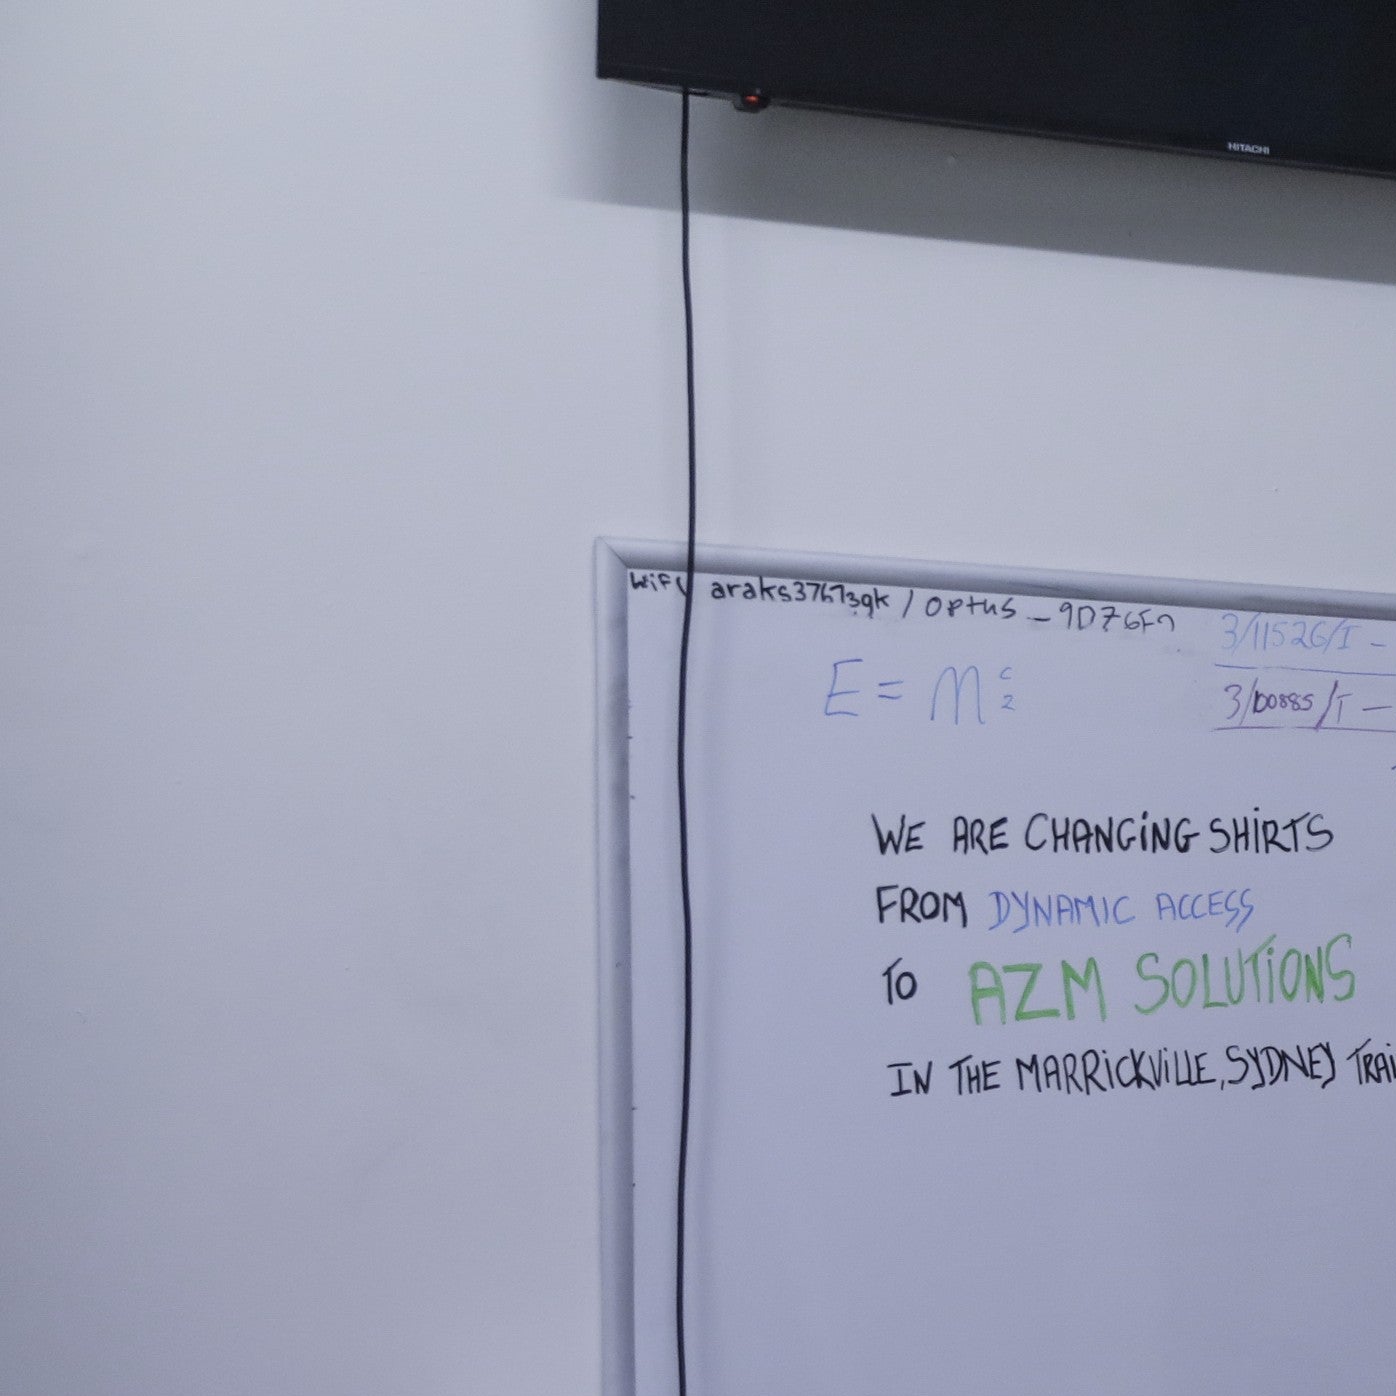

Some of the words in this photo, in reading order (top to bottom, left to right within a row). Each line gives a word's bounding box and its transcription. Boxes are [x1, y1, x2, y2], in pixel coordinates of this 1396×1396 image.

[872, 813, 926, 855] WE
[953, 815, 1010, 855] ARE
[876, 884, 968, 928] FROM
[988, 891, 1136, 933] DYNAMIC
[1156, 888, 1255, 933] ACCESS
[882, 957, 918, 1005] TO
[968, 957, 1108, 1026] AZM
[887, 1060, 932, 1097] IN
[949, 1055, 1001, 1095] THE
